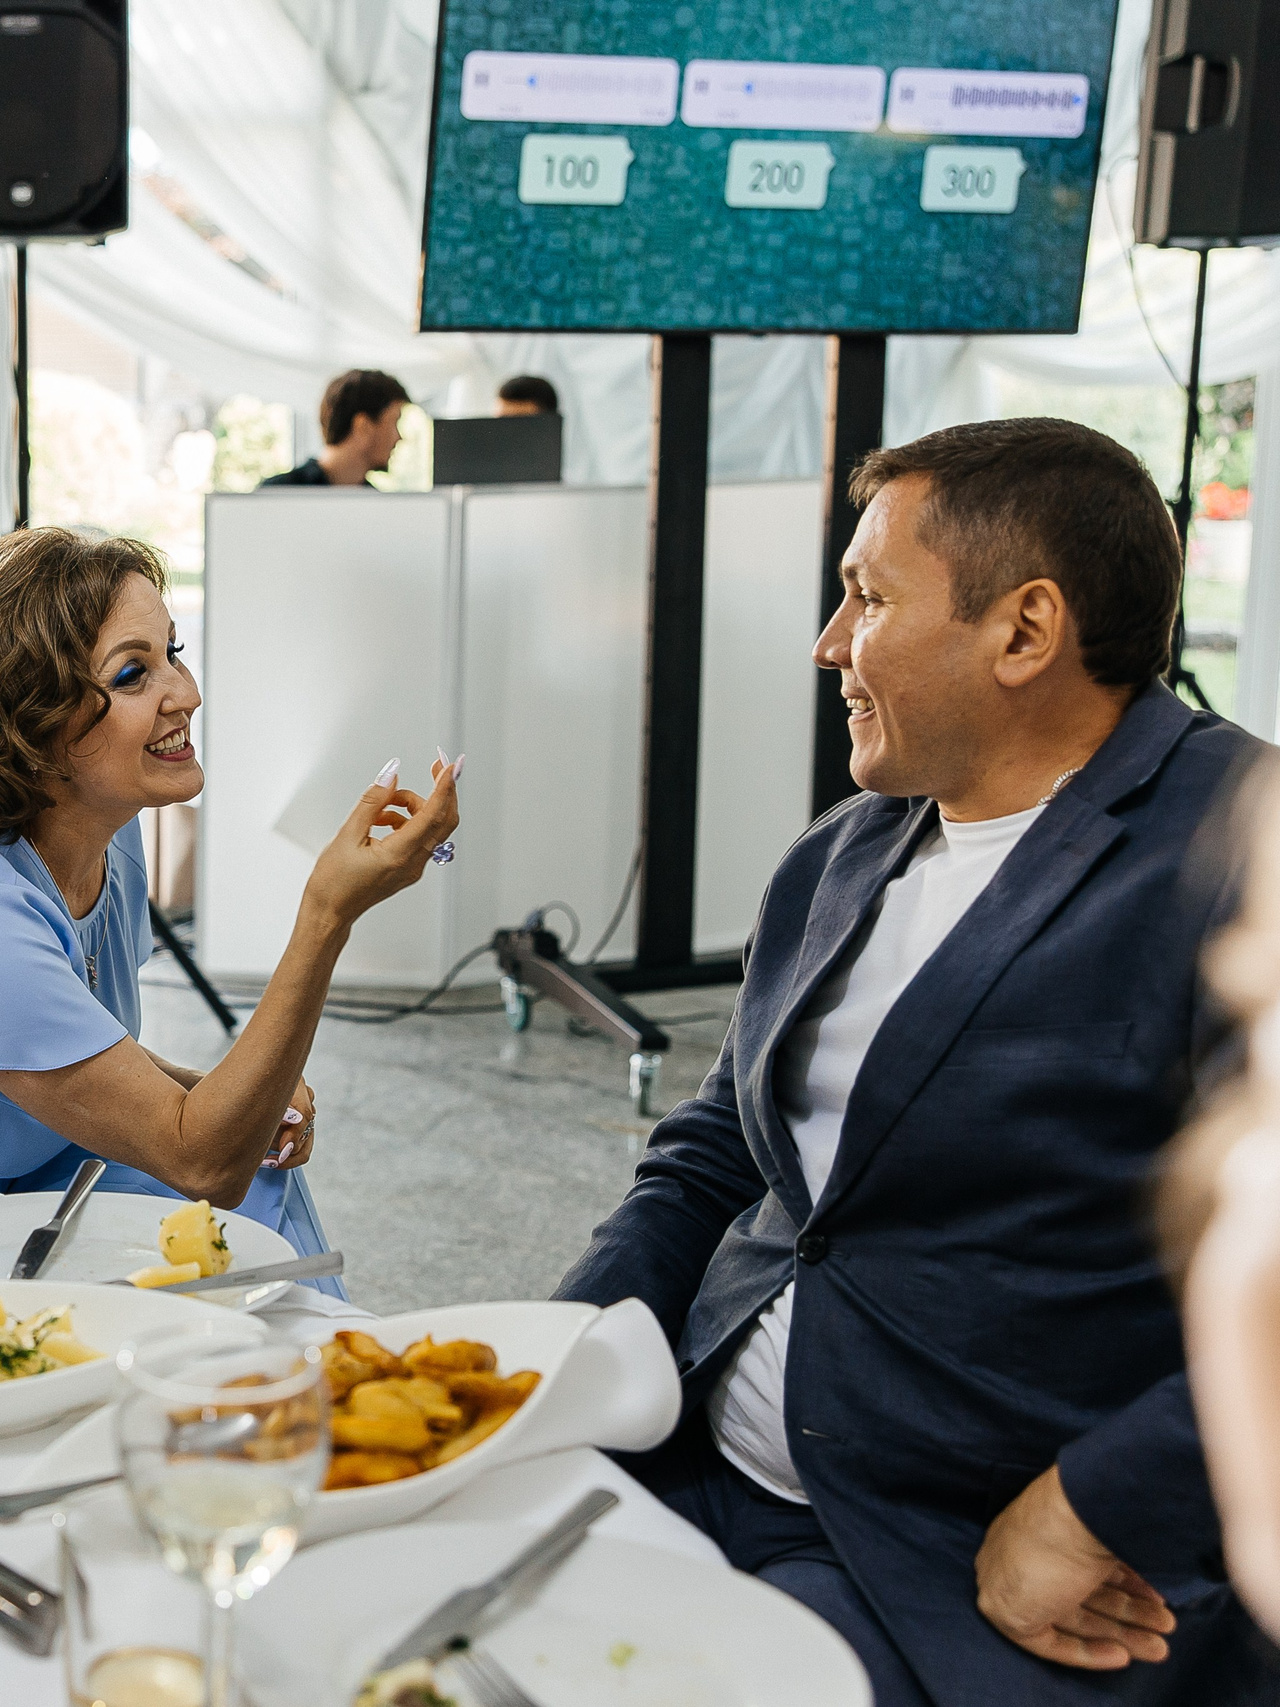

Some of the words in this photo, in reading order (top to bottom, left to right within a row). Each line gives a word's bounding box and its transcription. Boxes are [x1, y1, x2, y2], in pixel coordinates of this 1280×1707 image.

[543, 154, 599, 189] 100
[748, 159, 805, 194] 200
[940, 163, 996, 198] 300
